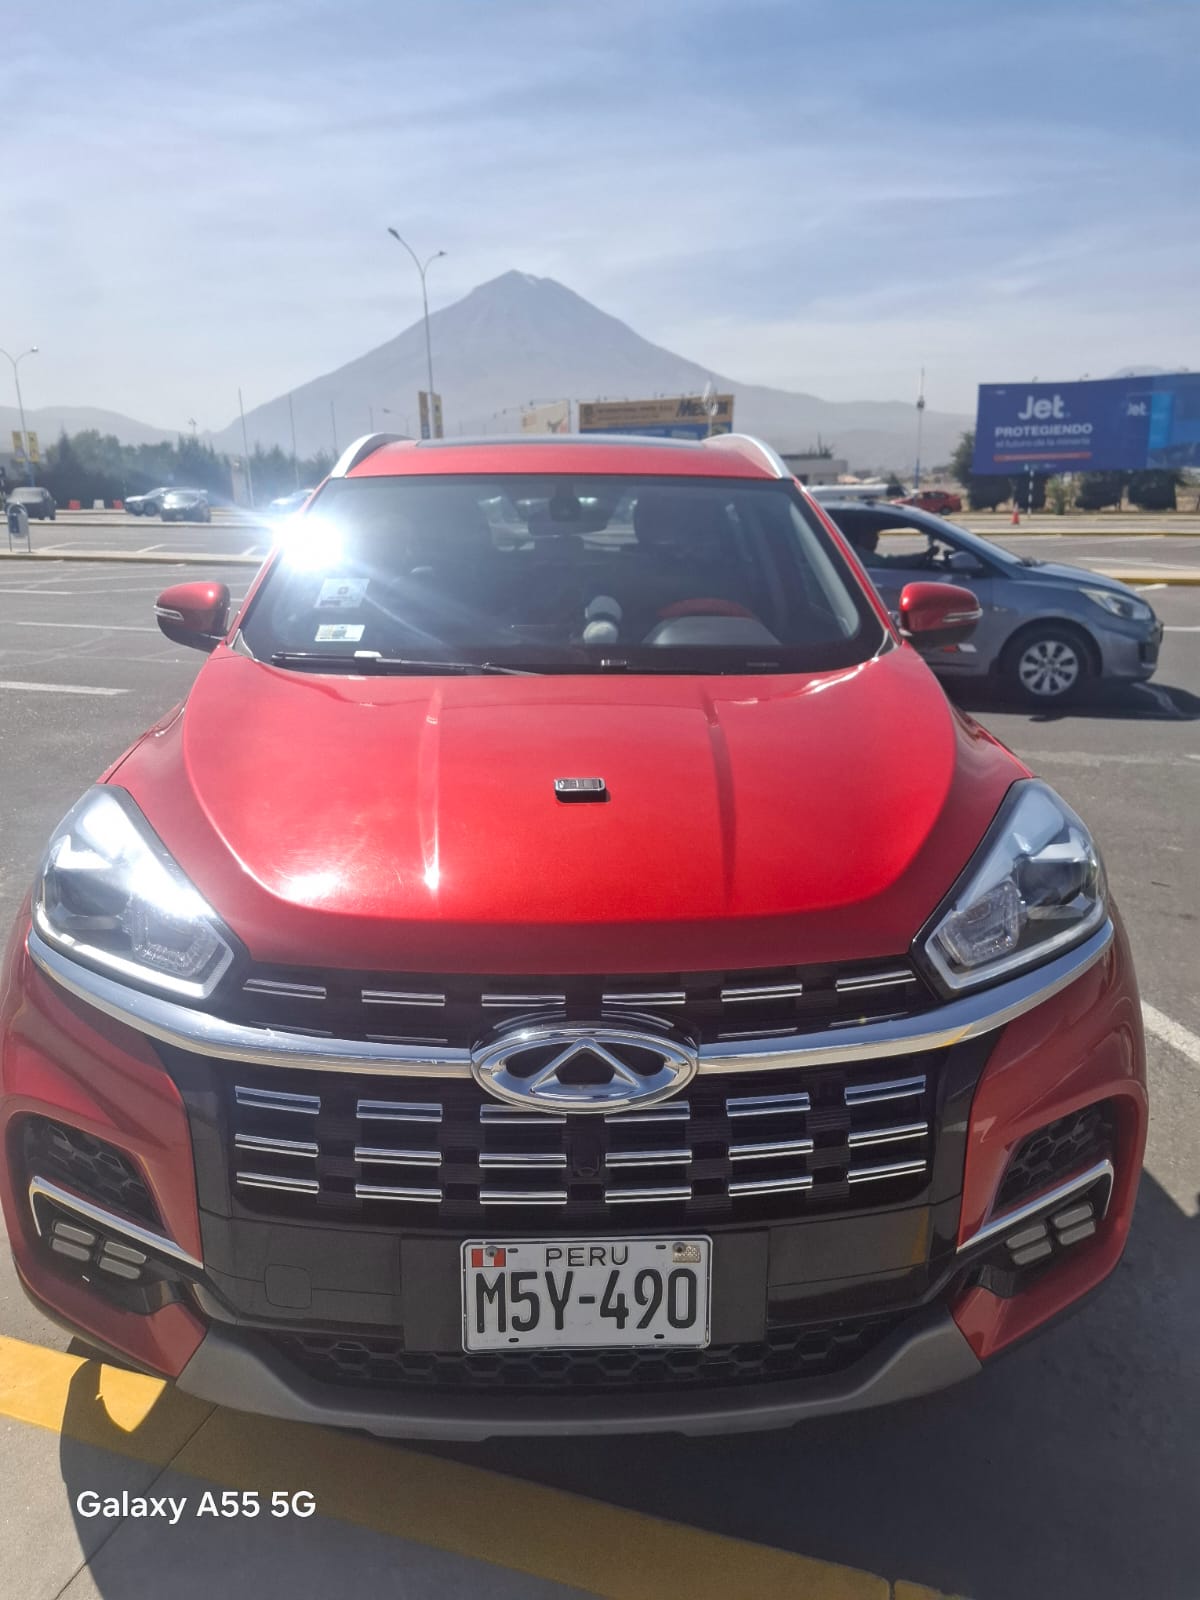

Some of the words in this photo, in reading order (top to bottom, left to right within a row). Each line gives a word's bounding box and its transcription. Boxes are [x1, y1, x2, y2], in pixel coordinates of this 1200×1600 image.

[994, 423, 1093, 438] PROTEGIENDO
[545, 1245, 629, 1267] PERU
[475, 1268, 697, 1333] M5Y-490
